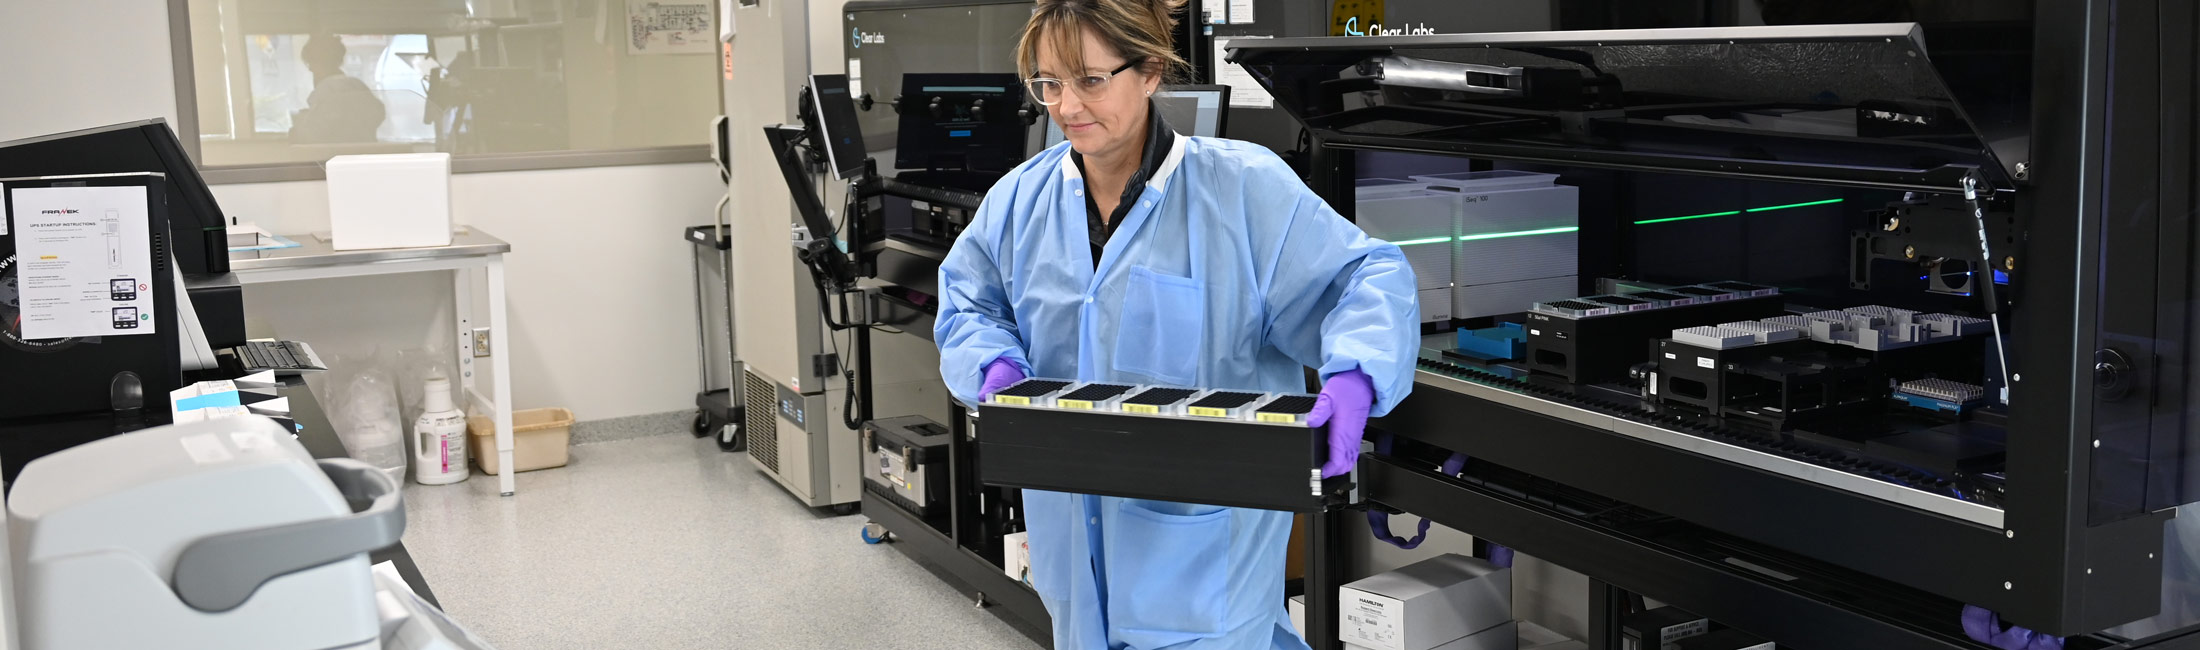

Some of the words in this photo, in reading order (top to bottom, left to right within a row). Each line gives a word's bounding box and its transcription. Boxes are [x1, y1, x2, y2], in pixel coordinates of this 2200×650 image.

[1369, 23, 1402, 36] Clear
[1405, 22, 1435, 36] Labs
[861, 31, 873, 43] Clear
[873, 31, 885, 43] Labs
[41, 206, 80, 216] FRANEK
[1359, 597, 1384, 608] HAMILTON
